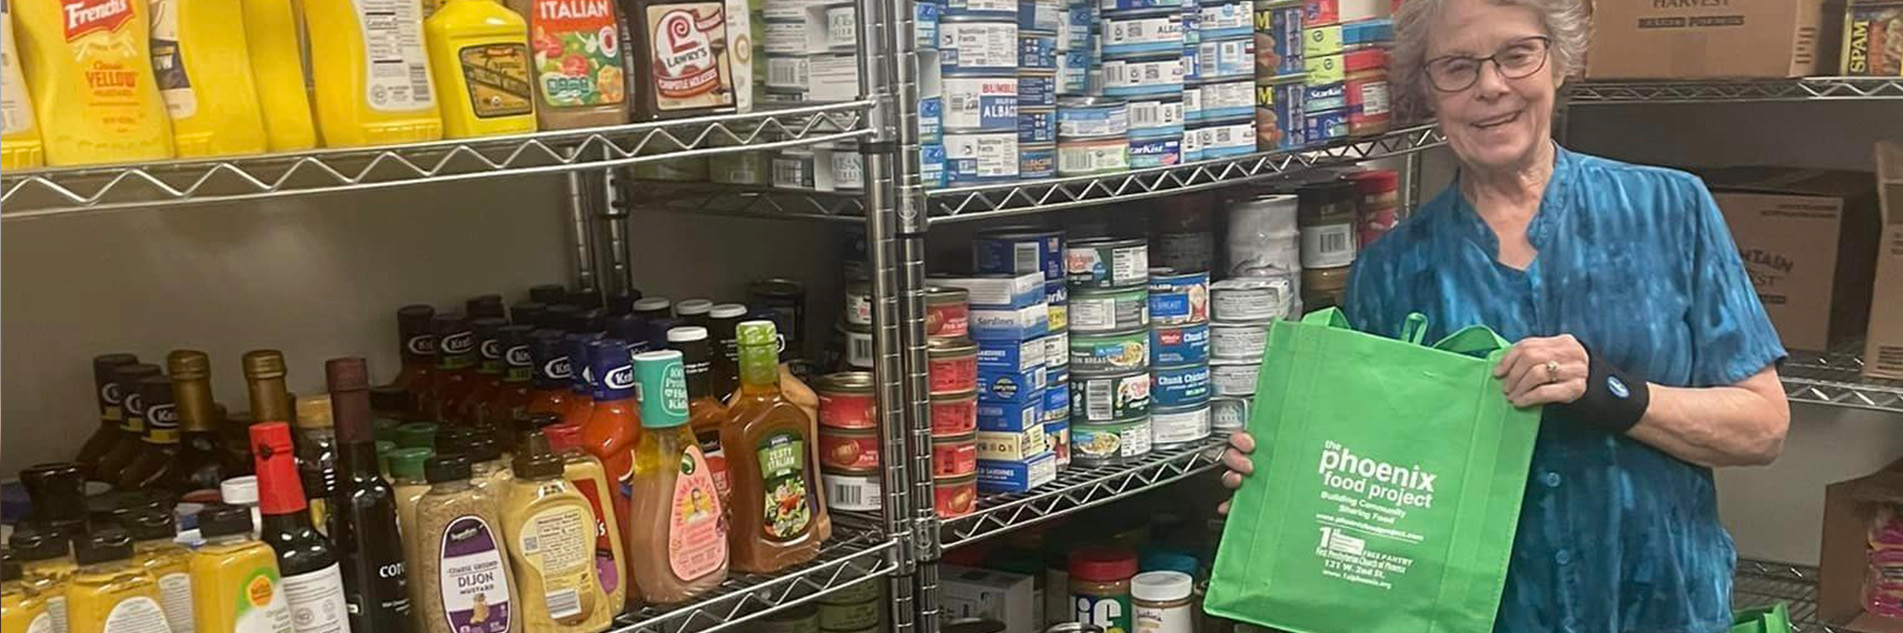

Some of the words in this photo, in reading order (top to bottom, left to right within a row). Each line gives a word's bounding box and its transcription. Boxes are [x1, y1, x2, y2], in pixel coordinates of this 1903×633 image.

[539, 0, 609, 19] ITALIAN
[1850, 20, 1870, 73] SPAM
[666, 47, 708, 69] LAWRY'S
[85, 71, 139, 88] YELLOW
[977, 316, 1015, 326] Sardines
[1324, 440, 1342, 451] the
[1319, 447, 1437, 493] phoenix
[1323, 470, 1367, 494] food
[1367, 484, 1433, 509] project
[1320, 491, 1358, 506] Building
[1359, 499, 1407, 519] Community
[1338, 503, 1372, 520] Sharing
[1372, 512, 1396, 524] Food
[473, 561, 498, 570] GROUND
[1363, 550, 1381, 560] FREE
[1381, 553, 1414, 567] PANTRY
[1324, 559, 1341, 569] 121
[1356, 566, 1373, 576] 2nd
[457, 571, 495, 588] DIJON
[460, 584, 495, 595] MUSTARD
